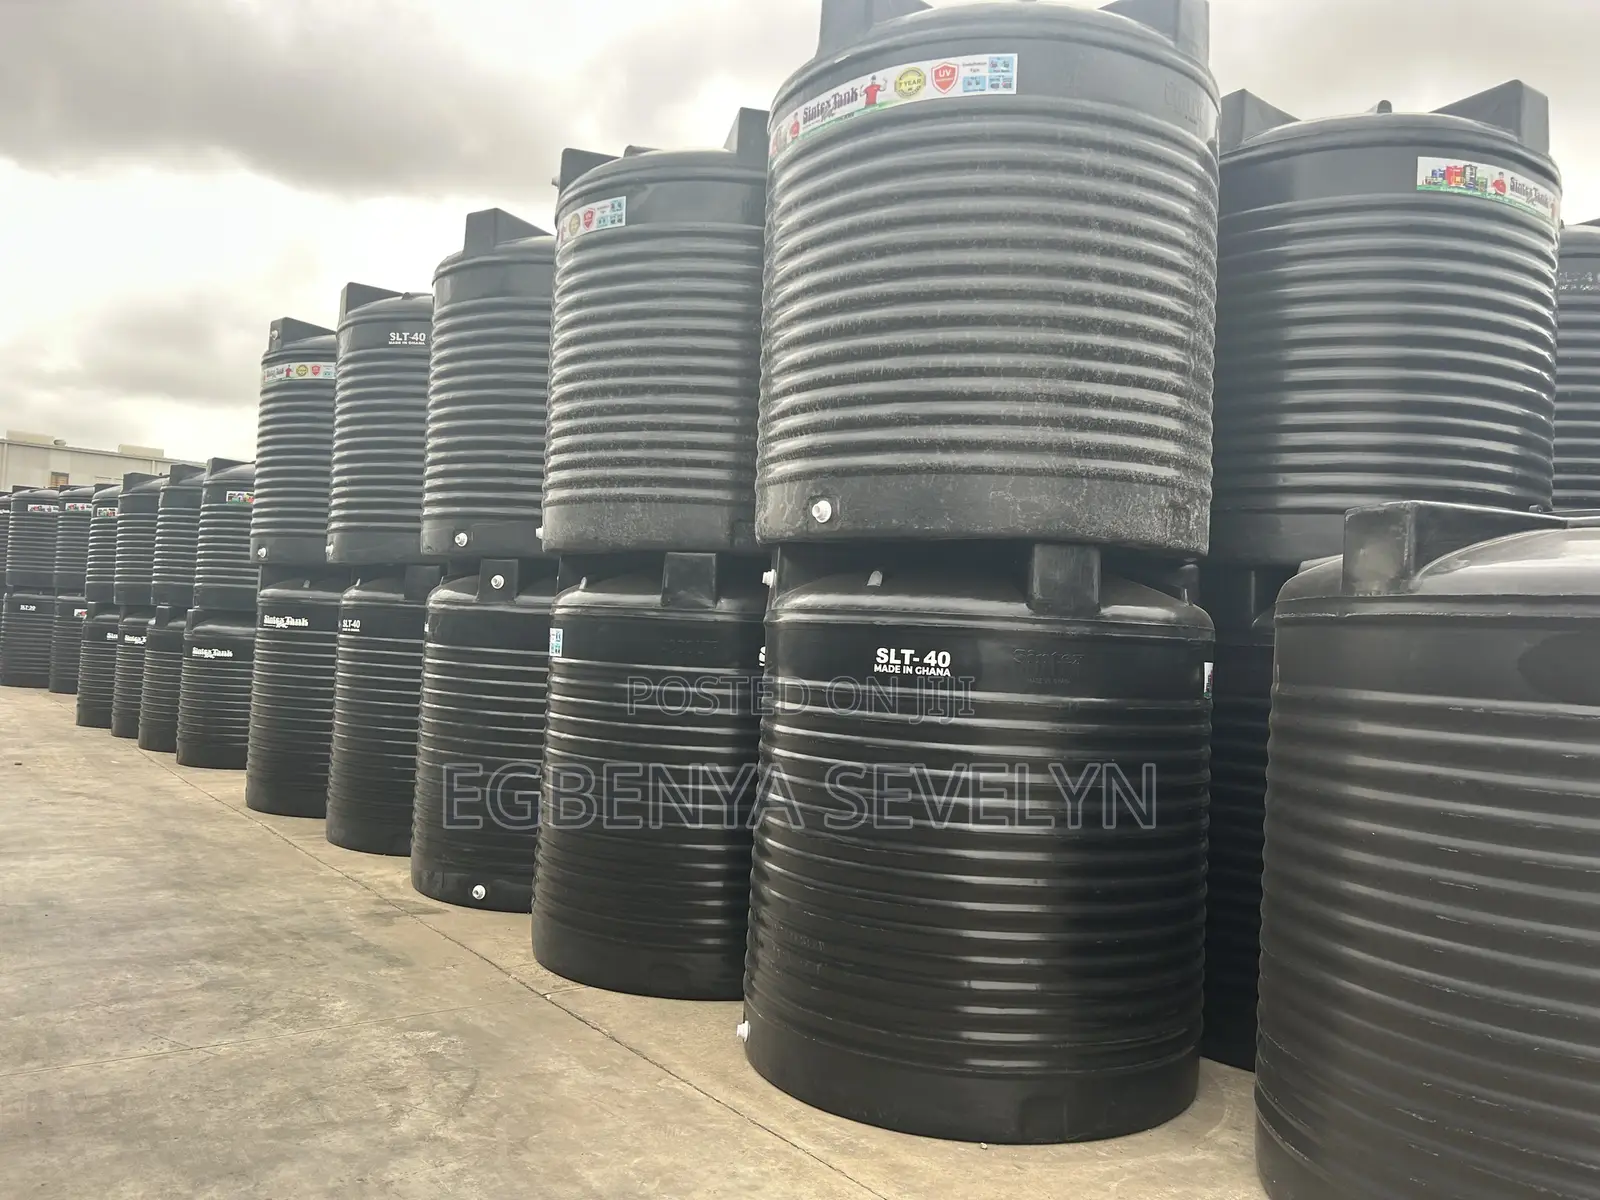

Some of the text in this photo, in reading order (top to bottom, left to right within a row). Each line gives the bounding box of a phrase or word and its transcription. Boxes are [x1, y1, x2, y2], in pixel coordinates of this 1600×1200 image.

[939, 69, 952, 78] UV
[873, 664, 951, 677] MADE IN GHANA
